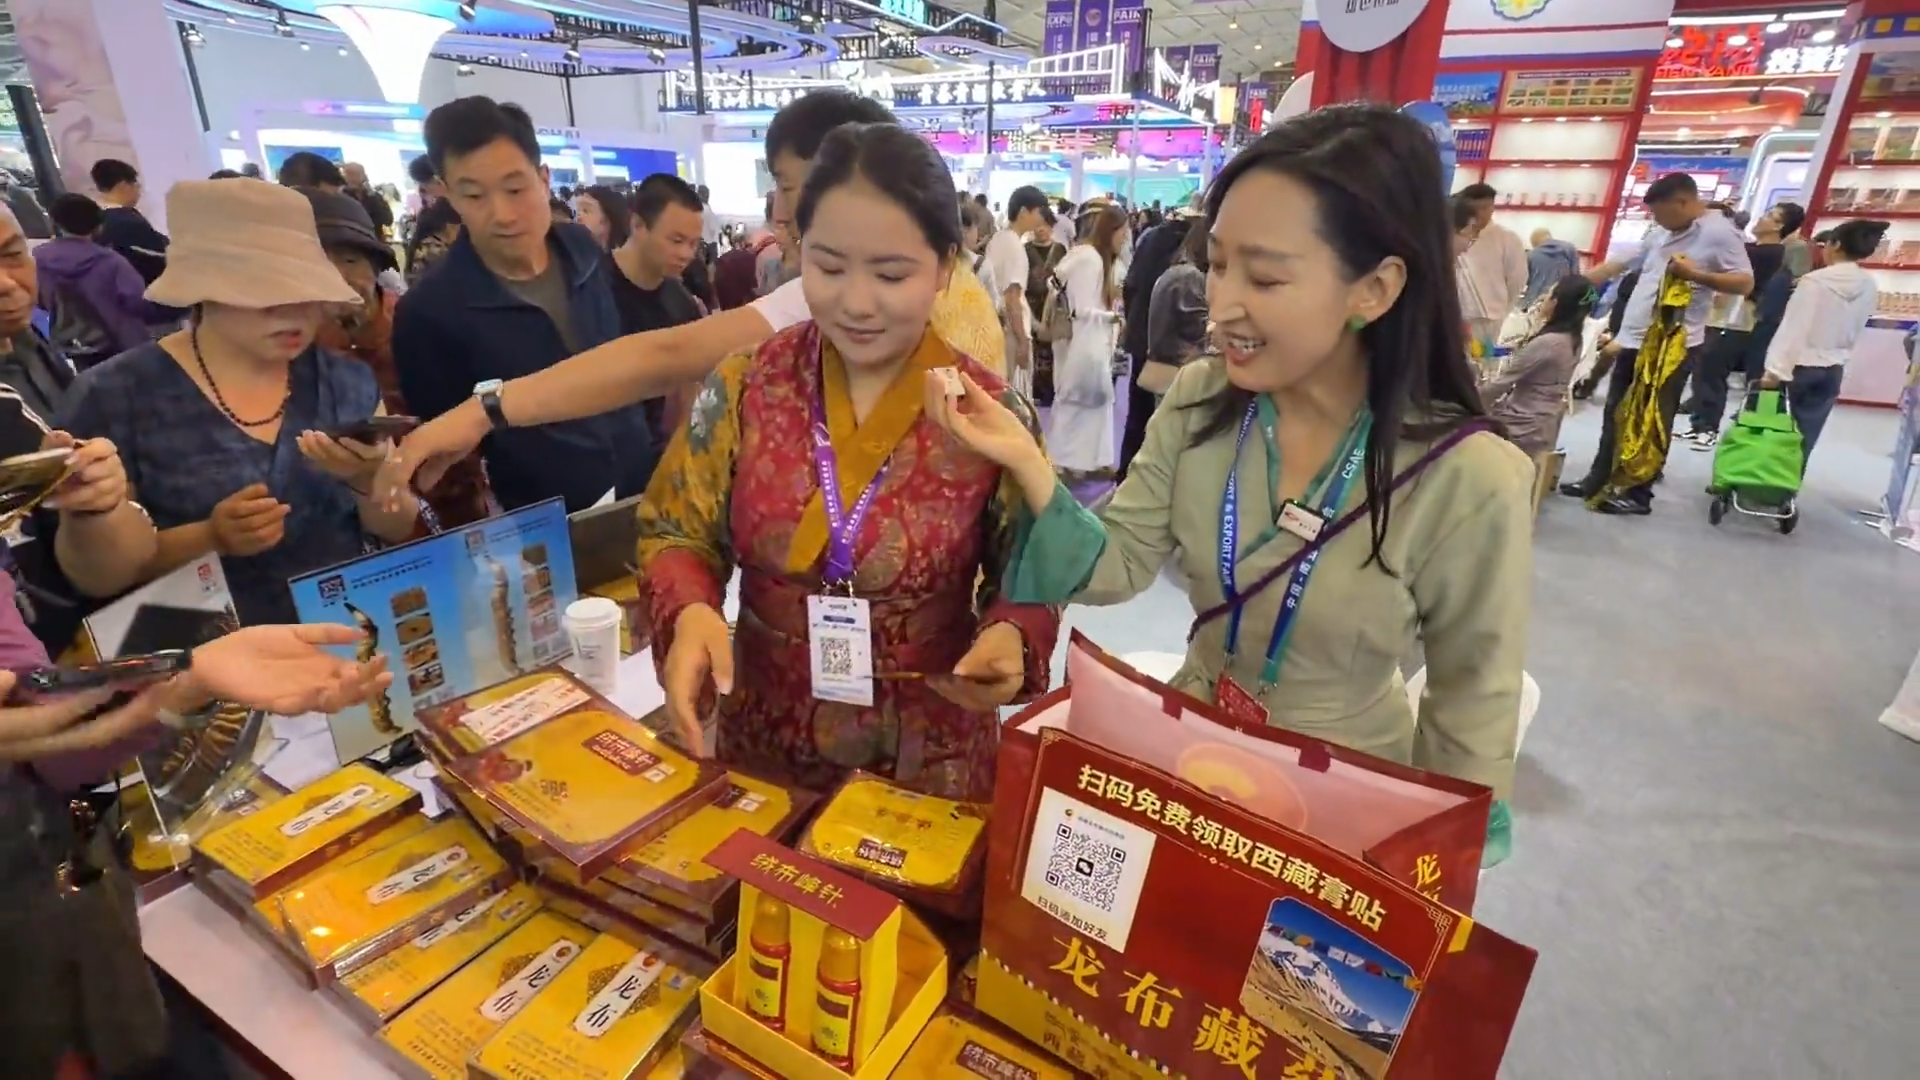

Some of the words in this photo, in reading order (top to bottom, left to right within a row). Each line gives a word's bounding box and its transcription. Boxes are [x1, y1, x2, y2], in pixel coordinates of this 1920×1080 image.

[1222, 514, 1234, 560] EXPORT
[1076, 762, 1389, 933] 扫码免费领取西藏膏贴
[1037, 896, 1109, 942] 扫码添加好友
